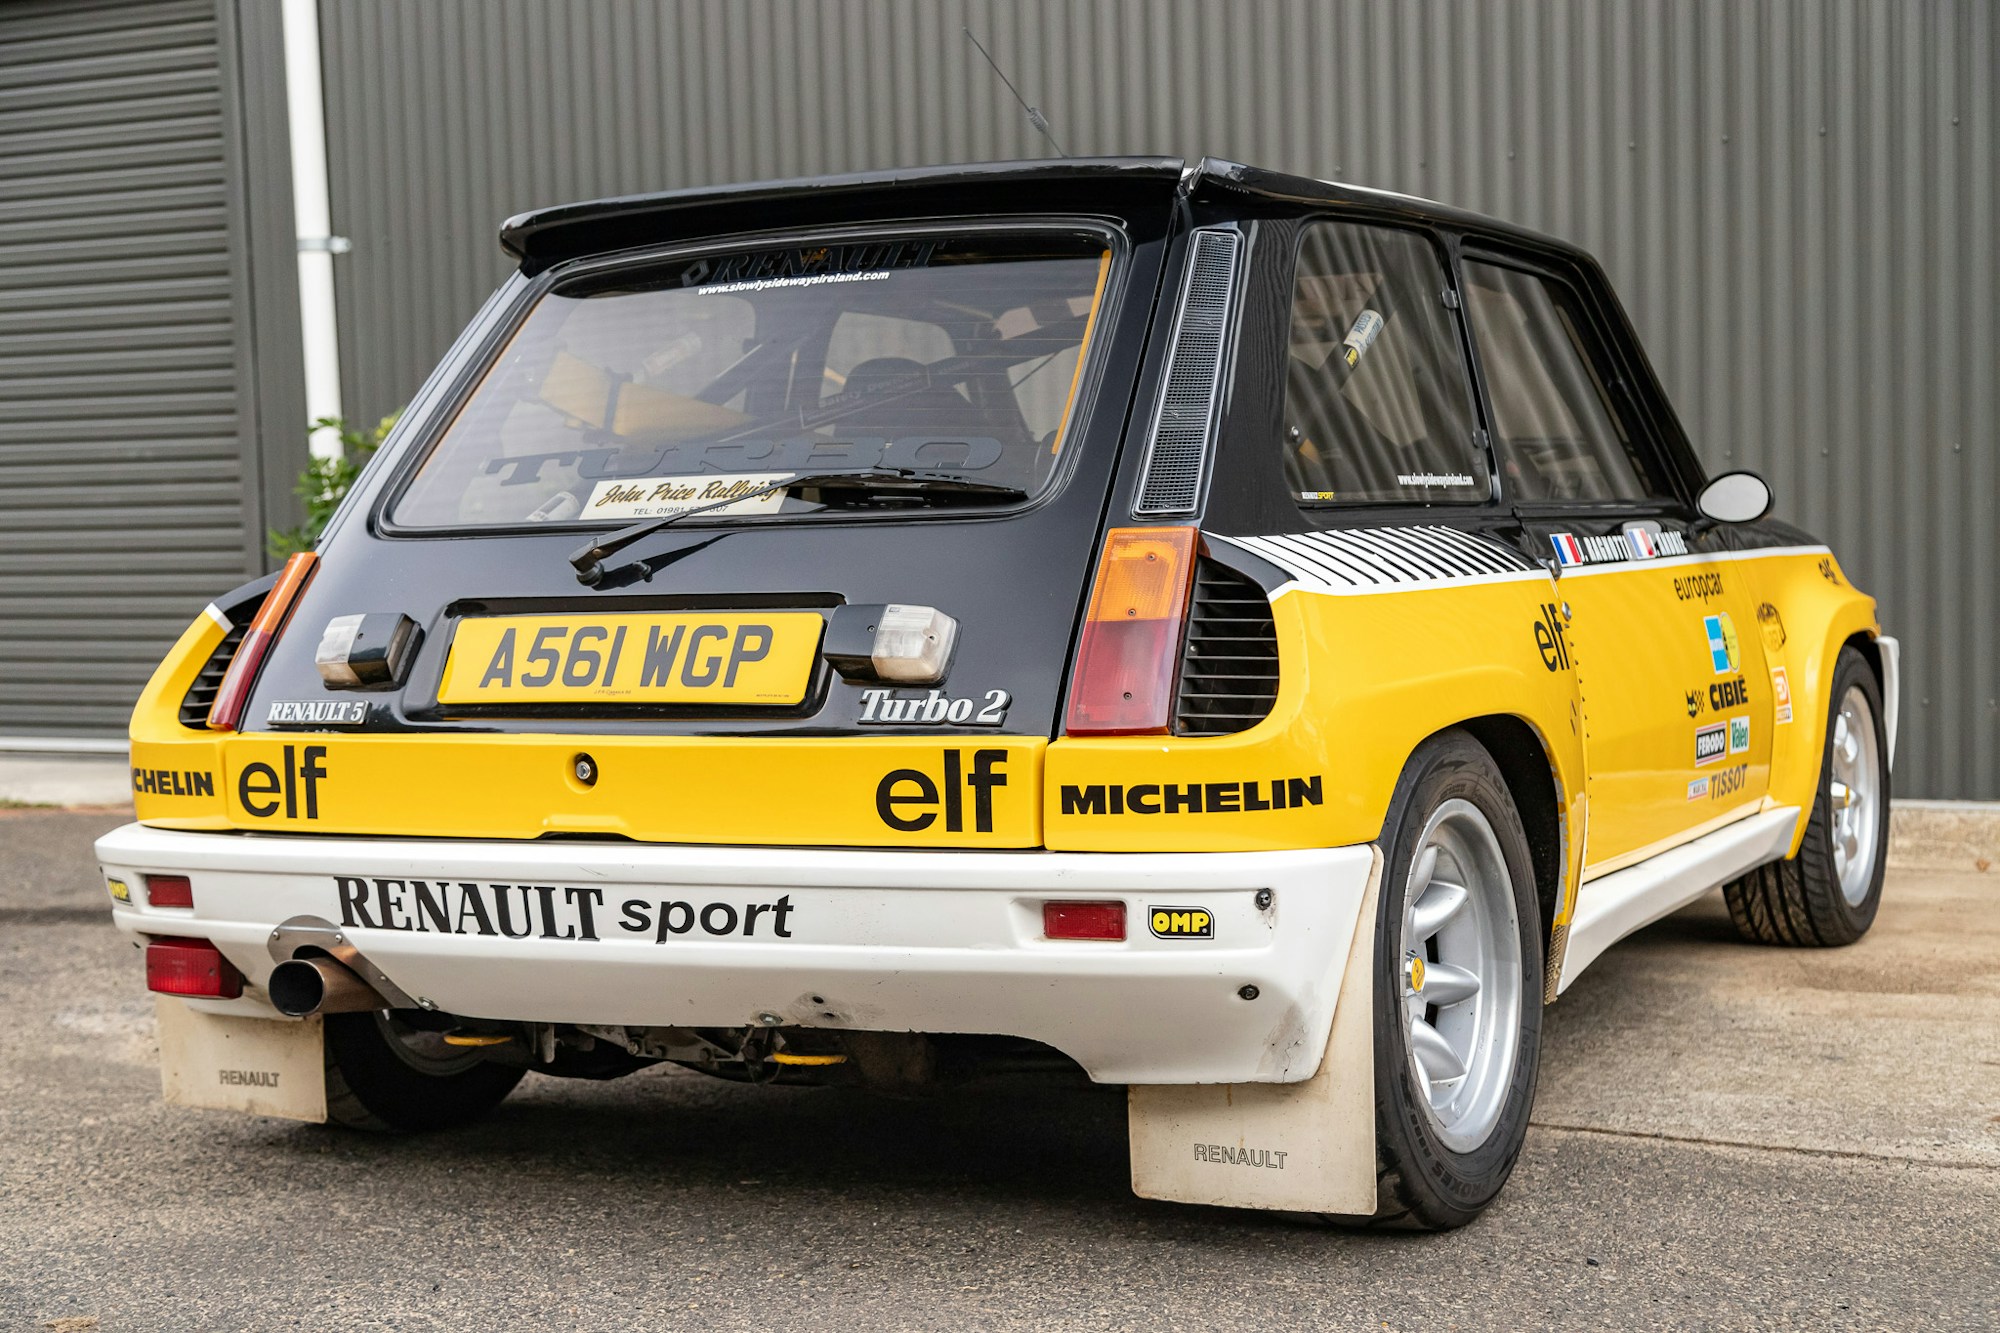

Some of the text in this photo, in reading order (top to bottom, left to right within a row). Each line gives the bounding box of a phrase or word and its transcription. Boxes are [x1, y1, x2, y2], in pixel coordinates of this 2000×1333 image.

[707, 240, 947, 284] RENAULT
[698, 271, 890, 296] www.slowlysidewaysireland.com
[485, 436, 1003, 487] TURBO
[595, 479, 780, 507] John Price Rallyig
[1674, 571, 1724, 605] europcar
[1534, 603, 1570, 672] elf
[478, 624, 774, 688] A561 WGP
[266, 700, 365, 722] RENAULT 5
[860, 689, 1009, 724] Turbo 2
[1697, 730, 1726, 757] FERODO
[1731, 721, 1749, 750] Valeo
[238, 744, 327, 820] elf
[875, 749, 1008, 833] elf
[1060, 775, 1323, 815] MICHELIN
[1711, 763, 1748, 800] TISSOT
[333, 875, 794, 944] RENAULT sport
[1152, 911, 1210, 934] OMP
[219, 1069, 281, 1088] RENAULT
[1193, 1143, 1288, 1170] RENAULT
